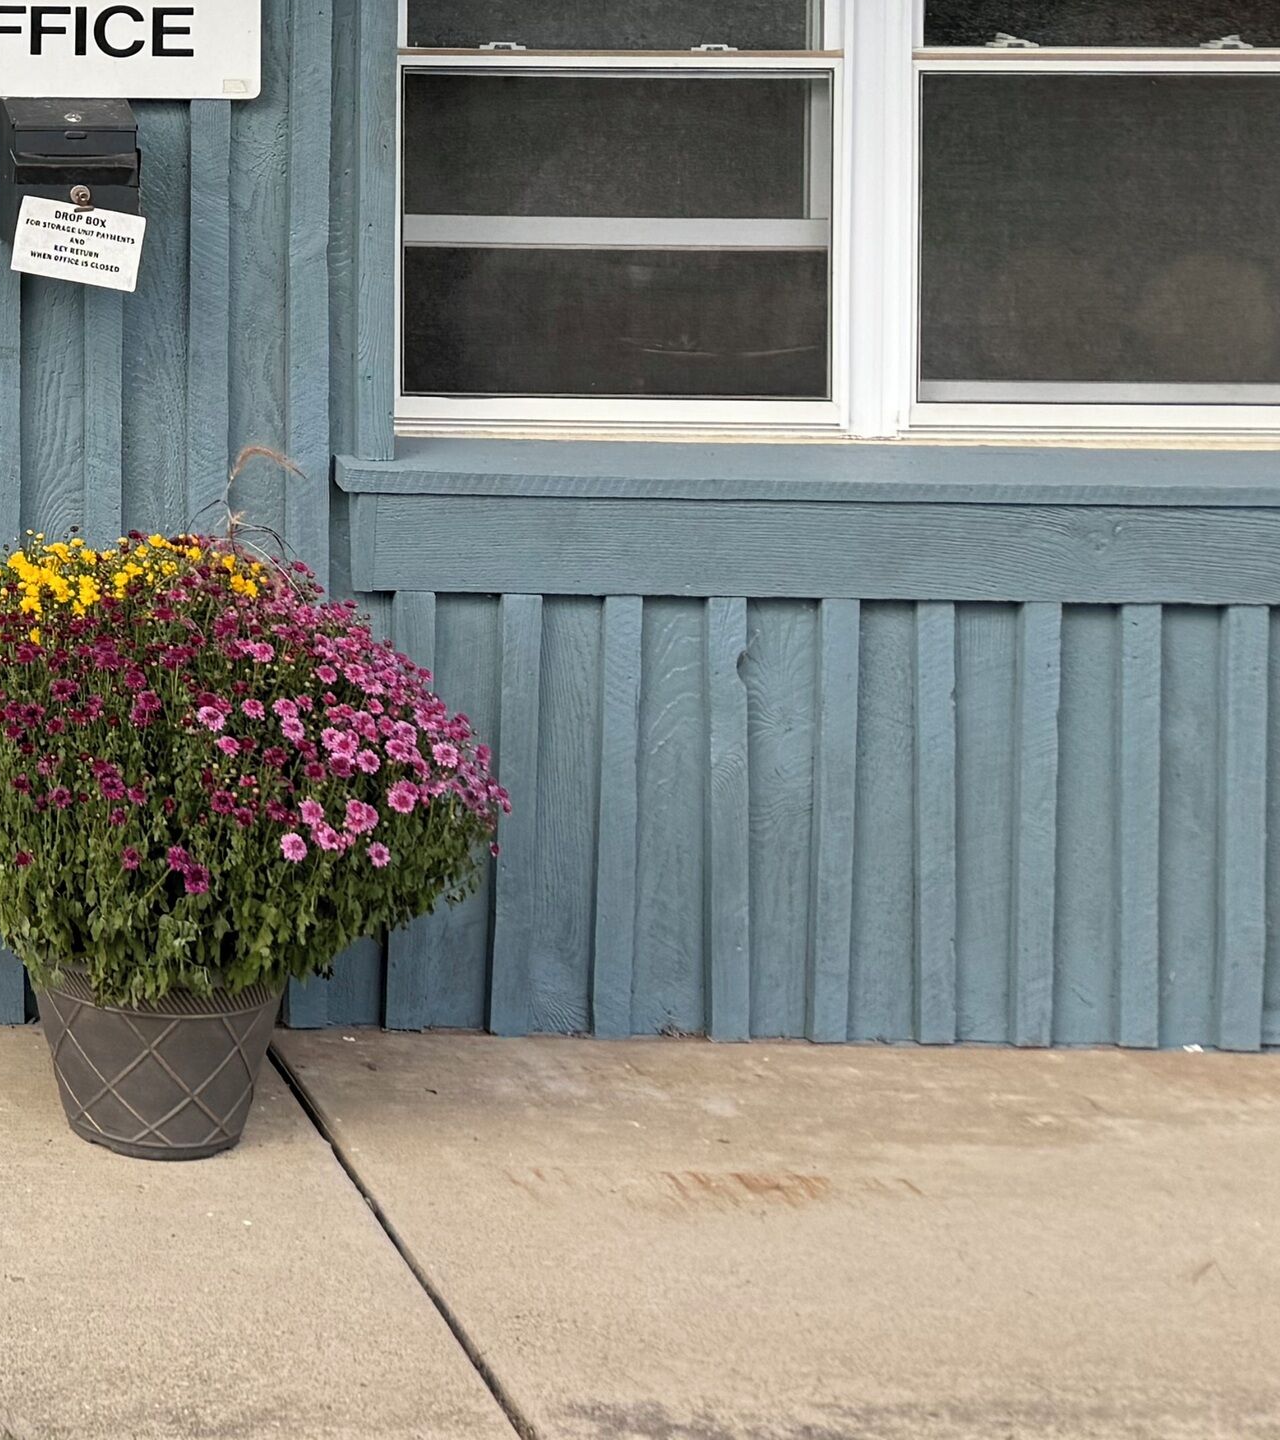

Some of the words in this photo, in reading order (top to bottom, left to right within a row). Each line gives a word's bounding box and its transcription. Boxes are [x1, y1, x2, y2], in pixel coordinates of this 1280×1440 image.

[55, 210, 83, 222] DROP
[85, 216, 107, 228] BOX
[26, 218, 41, 226] FOR
[42, 221, 76, 233] STORAGE
[77, 228, 95, 237] UNIT
[96, 232, 135, 244] PAYMENTS
[69, 237, 85, 245] AND
[53, 244, 68, 252] KEY
[70, 248, 99, 258] RETURN
[31, 250, 52, 260] WHEN
[54, 255, 79, 265] OFFICE
[90, 262, 120, 272] CLOSED
